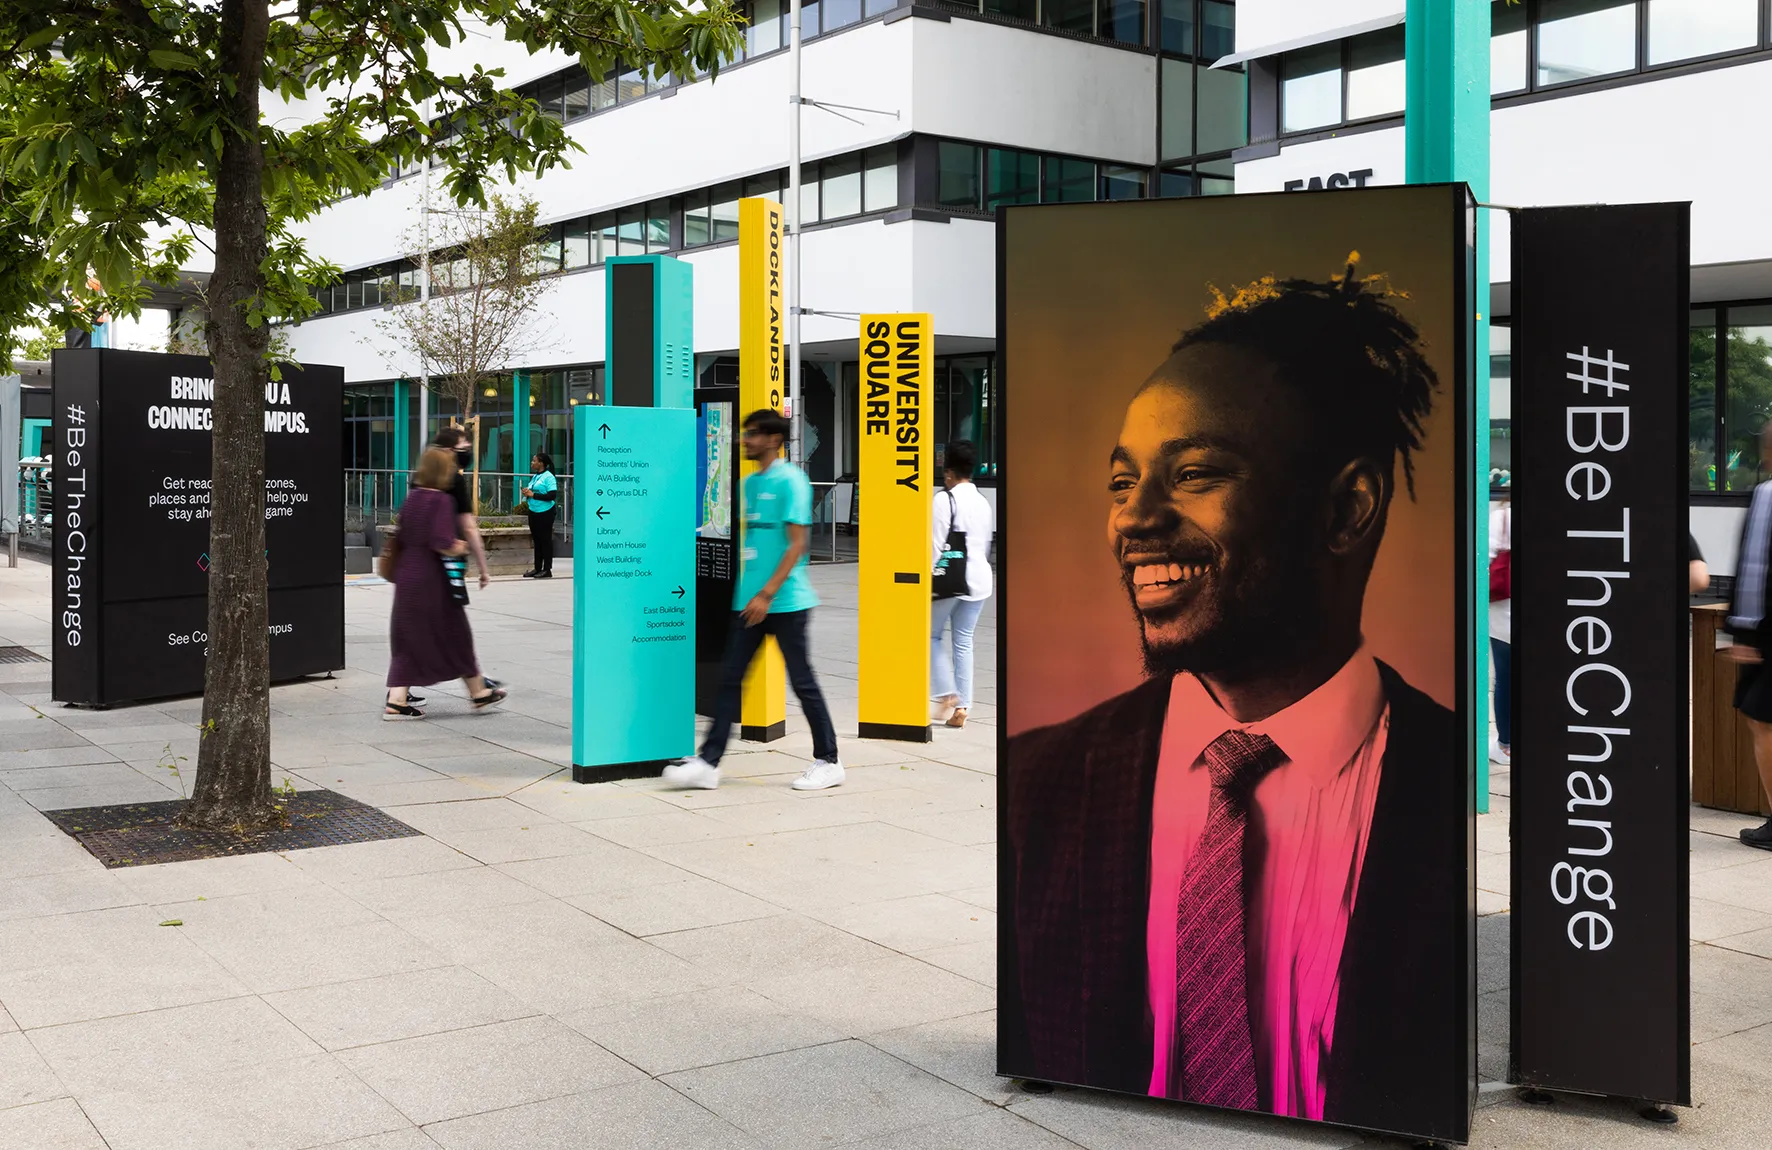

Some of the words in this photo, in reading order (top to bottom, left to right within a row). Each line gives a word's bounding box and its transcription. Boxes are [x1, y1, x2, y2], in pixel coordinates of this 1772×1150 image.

[769, 210, 779, 382] DOCKLANDS
[865, 322, 890, 435] SQUARE
[280, 383, 291, 405] A
[896, 322, 919, 491] UNIVERSITY
[148, 406, 213, 430] CONNEC
[265, 411, 309, 433] MPUS.
[597, 445, 632, 455] Reception
[629, 460, 650, 469] Union
[163, 477, 185, 489] Get
[266, 480, 296, 490] zones,
[596, 474, 613, 482] AVA
[613, 474, 641, 484] Building
[150, 493, 186, 507] places
[189, 492, 209, 504] and
[267, 491, 288, 504] help
[291, 494, 308, 504] you
[606, 488, 632, 498] Cyprus
[632, 488, 648, 497] DLR
[168, 508, 193, 521] stay
[265, 507, 292, 519] game
[63, 404, 86, 646] #BeTheChange
[596, 527, 622, 536] Library
[596, 541, 624, 550] Malvern
[624, 541, 647, 549] House
[596, 556, 614, 564] West
[615, 555, 642, 565] Building
[596, 570, 634, 580] Knowledge
[634, 569, 653, 577] Dock
[643, 606, 659, 615] East
[659, 606, 686, 615] Building
[646, 619, 685, 630] Sportsdock
[169, 633, 189, 645] See
[268, 624, 292, 636] mpus
[631, 633, 687, 643] Accommodation
[1551, 346, 1631, 950] #BeTheChange
